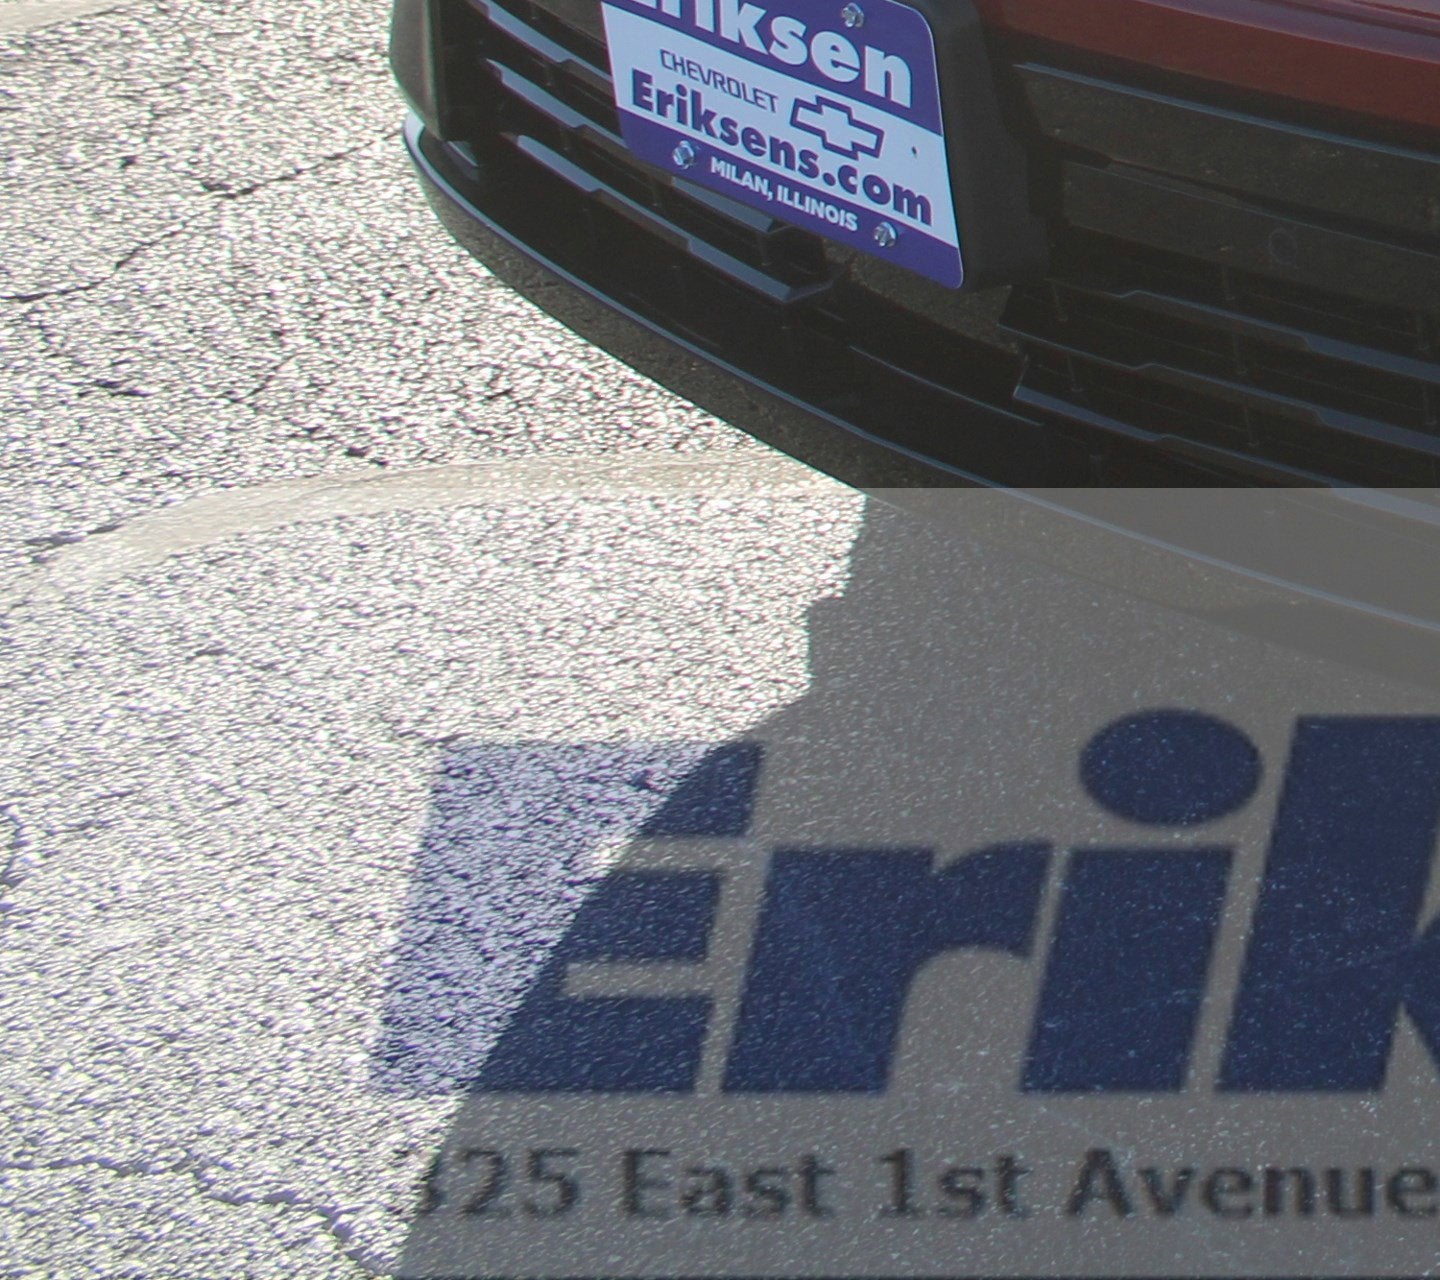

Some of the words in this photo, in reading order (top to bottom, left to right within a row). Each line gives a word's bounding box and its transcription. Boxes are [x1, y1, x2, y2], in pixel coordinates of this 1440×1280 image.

[660, 48, 779, 114] CHEVROLET
[631, 67, 933, 227] Eriksens.com
[710, 156, 773, 202] MILAN,
[777, 184, 859, 233] ILLINOIS
